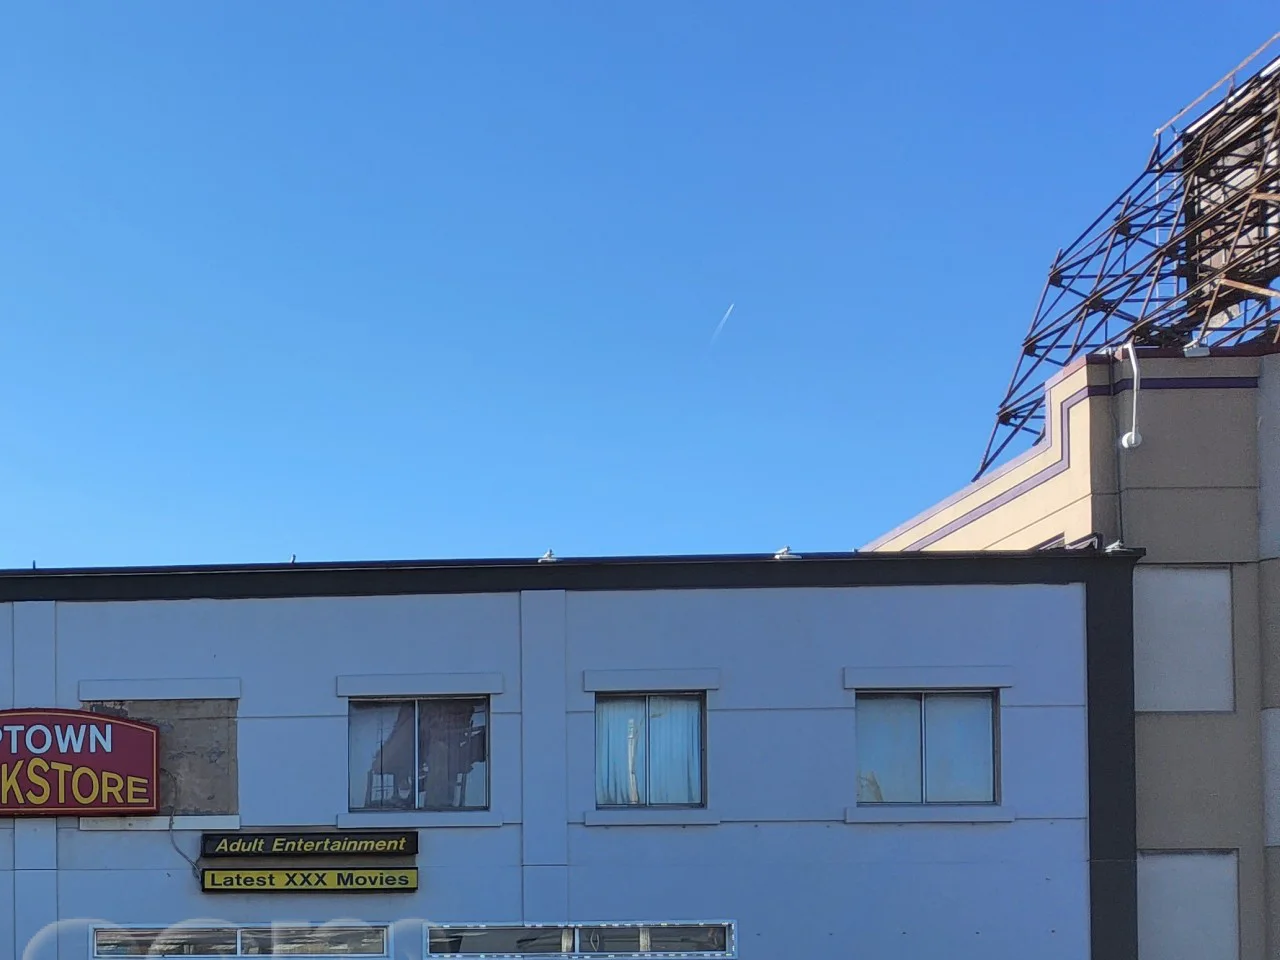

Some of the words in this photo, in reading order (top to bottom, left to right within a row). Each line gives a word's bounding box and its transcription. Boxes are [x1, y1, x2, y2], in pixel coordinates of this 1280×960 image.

[215, 838, 265, 852] Adult
[272, 837, 406, 852] Entertainment
[210, 873, 275, 887] Latest
[285, 873, 328, 887] XXX
[337, 872, 409, 887] Movies
